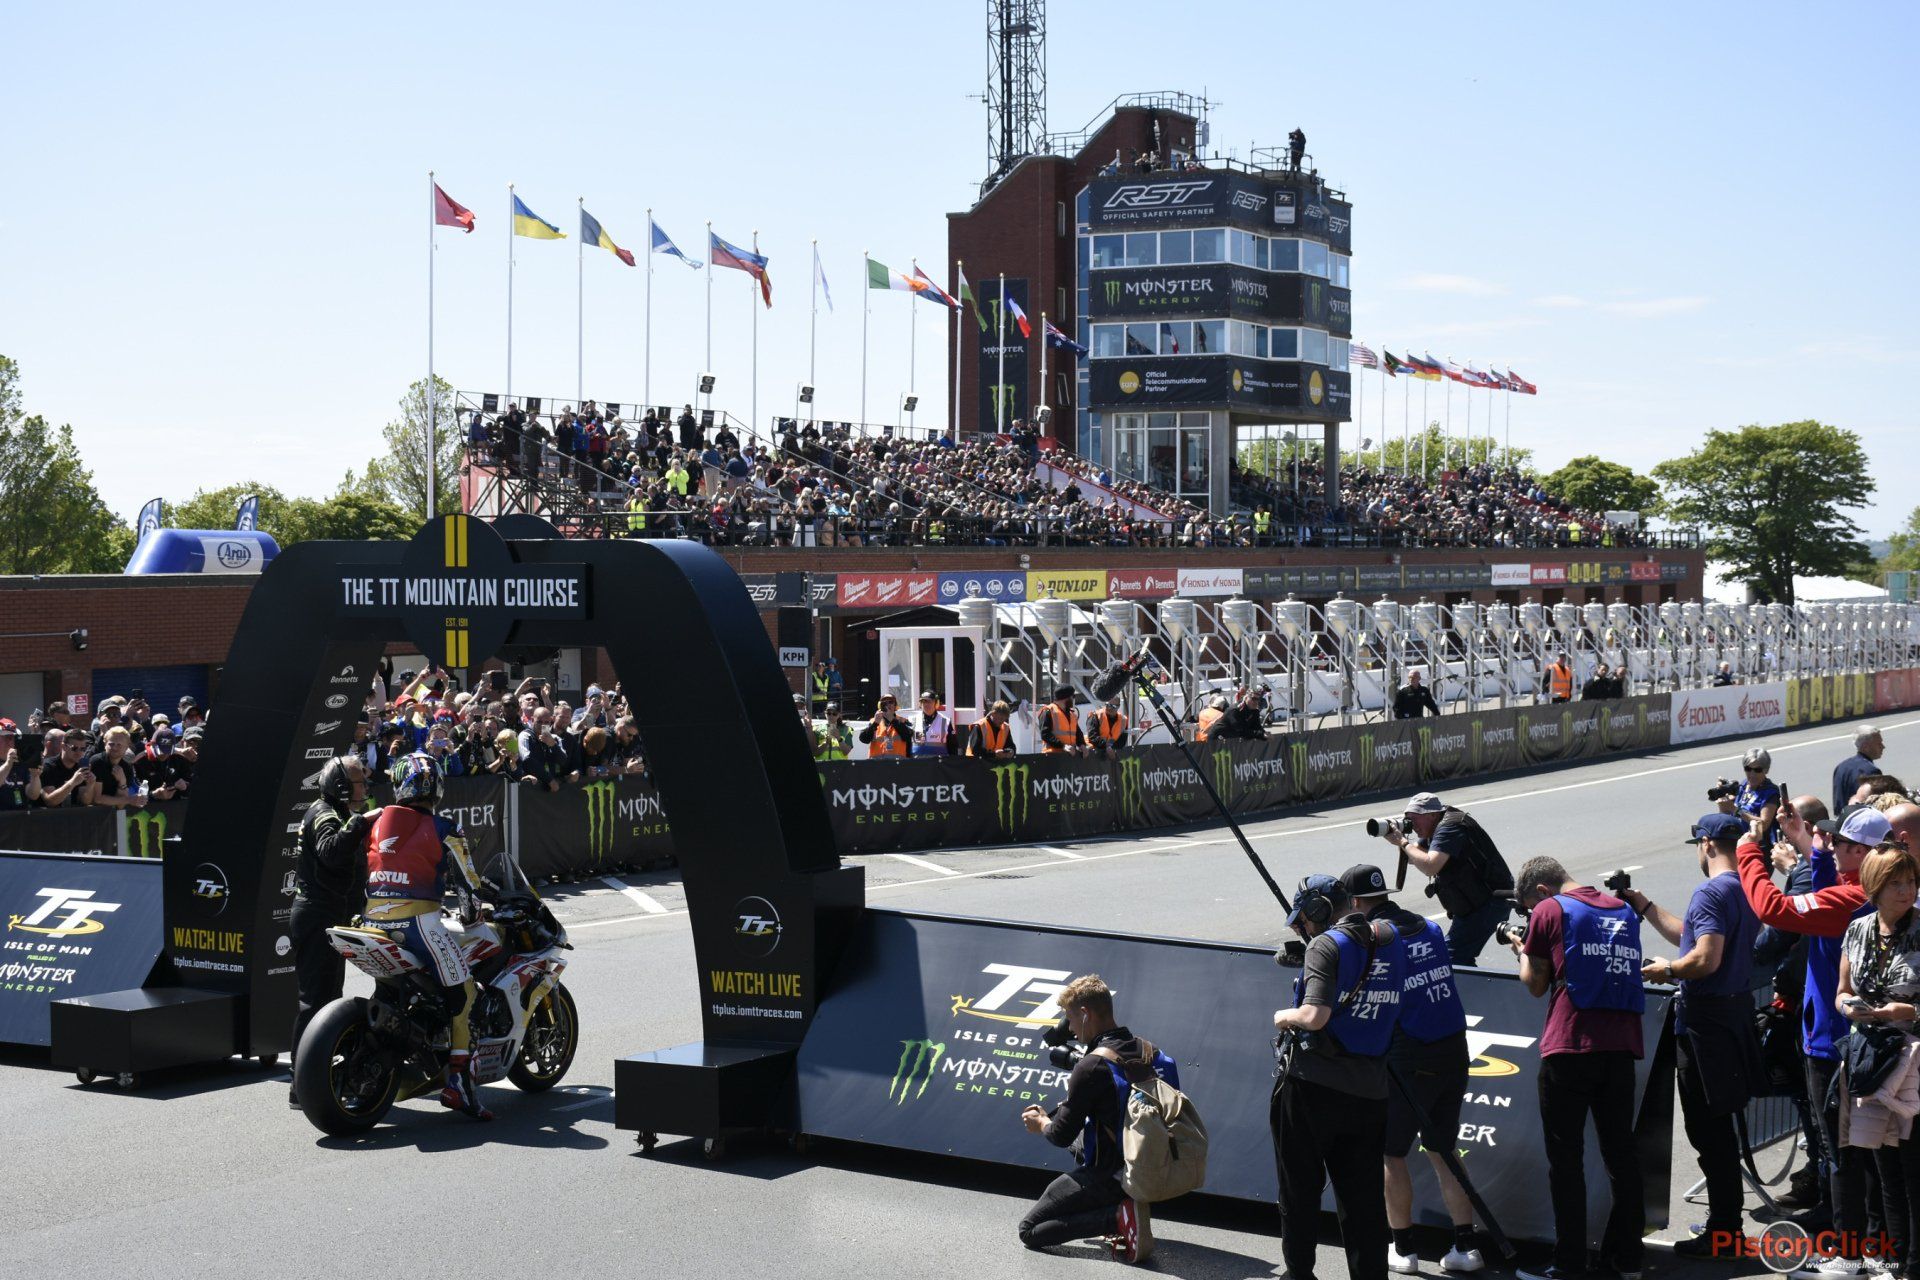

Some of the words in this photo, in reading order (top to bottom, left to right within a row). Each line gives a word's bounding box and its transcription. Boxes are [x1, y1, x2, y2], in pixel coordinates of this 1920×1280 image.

[1103, 181, 1213, 207] RST
[1232, 190, 1267, 211] RST
[1177, 208, 1214, 216] PARTNER
[1328, 216, 1349, 233] ST
[1125, 278, 1214, 296] MONSTER
[1231, 277, 1268, 299] MONSTER
[1139, 296, 1200, 305] ENERGY
[222, 544, 247, 561] Arai
[1048, 579, 1098, 593] DUNLOP
[1120, 580, 1141, 590] Bennetts
[1155, 579, 1175, 589] Bennetts
[1187, 580, 1210, 588] HONDA
[1220, 579, 1240, 587] HONDA
[342, 578, 374, 605] THE
[379, 578, 399, 605] TT
[405, 578, 497, 606] MOUNTAIN
[504, 579, 579, 607] COURSE
[446, 618, 457, 627] EST.
[458, 617, 468, 627] 1911
[783, 652, 805, 661] KPH
[328, 696, 345, 704] Arai
[1749, 699, 1780, 718] HONDA
[1689, 704, 1727, 727] HONDA
[1374, 741, 1413, 762] MONSTER
[1432, 734, 1466, 754] MONSTER
[307, 749, 332, 757] MOTUL
[1309, 750, 1352, 771] MONSTER
[1234, 758, 1286, 782] MONSTER
[1033, 773, 1110, 799] MONSTER
[832, 783, 969, 810] MONSTER
[1049, 800, 1101, 813] ENERGY
[856, 811, 950, 824] ENERGY
[633, 824, 671, 836] ENER
[369, 870, 410, 885] MOTUL
[22, 887, 122, 938] TT
[4, 941, 34, 951] ISLE
[37, 943, 55, 952] OF
[59, 945, 92, 955] MAN
[173, 927, 215, 951] WATCH
[218, 931, 244, 953] LIVE
[1582, 943, 1611, 956] HOST
[1615, 945, 1640, 960] MEDI
[174, 957, 244, 973] ttplus.iomttraces.com
[1605, 957, 1632, 975] 254
[0, 982, 55, 993] NERGY
[711, 971, 765, 995] WATCH
[769, 974, 802, 997] LIVE
[1427, 982, 1451, 1003] 173
[1338, 990, 1366, 1003] HT
[1366, 990, 1400, 1004] MEDIA
[712, 1003, 802, 1019] ttplus.iomttraces.com
[1351, 1003, 1380, 1020] 121
[955, 1030, 997, 1043] ISLE
[1005, 1035, 1032, 1048] OF
[993, 1049, 1026, 1059] FUELLED
[1026, 1053, 1039, 1061] BY
[942, 1057, 1073, 1092] MONSTER
[955, 1082, 1048, 1102] ENERGY
